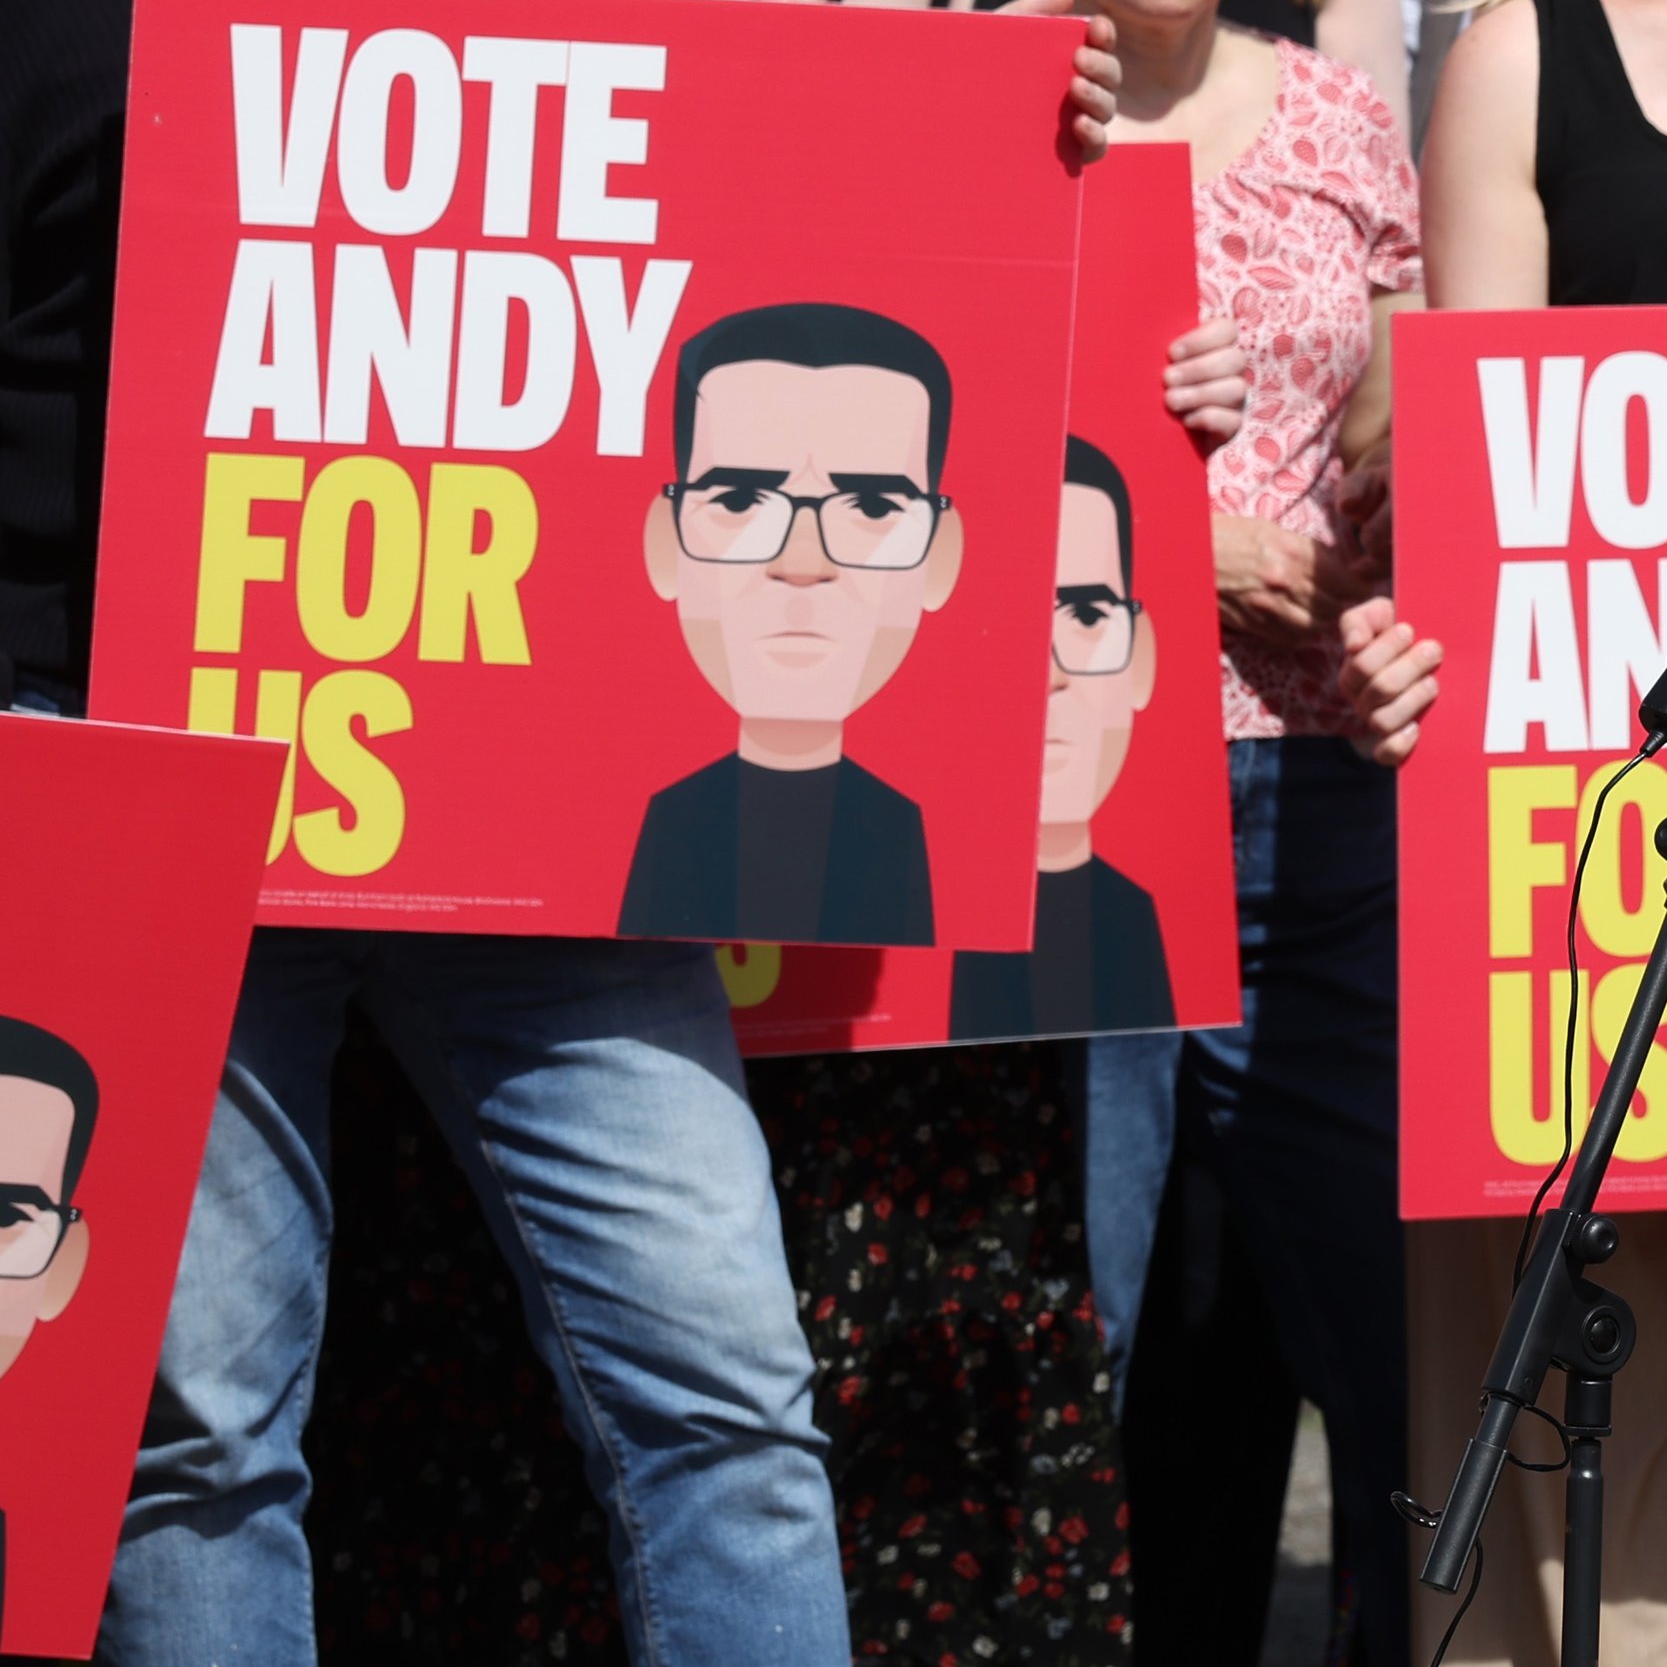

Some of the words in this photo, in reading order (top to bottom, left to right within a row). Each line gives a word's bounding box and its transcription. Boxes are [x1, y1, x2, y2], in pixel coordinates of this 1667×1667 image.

[230, 23, 667, 244] VOTE
[204, 239, 692, 457] ANDY
[193, 453, 539, 666] FOR
